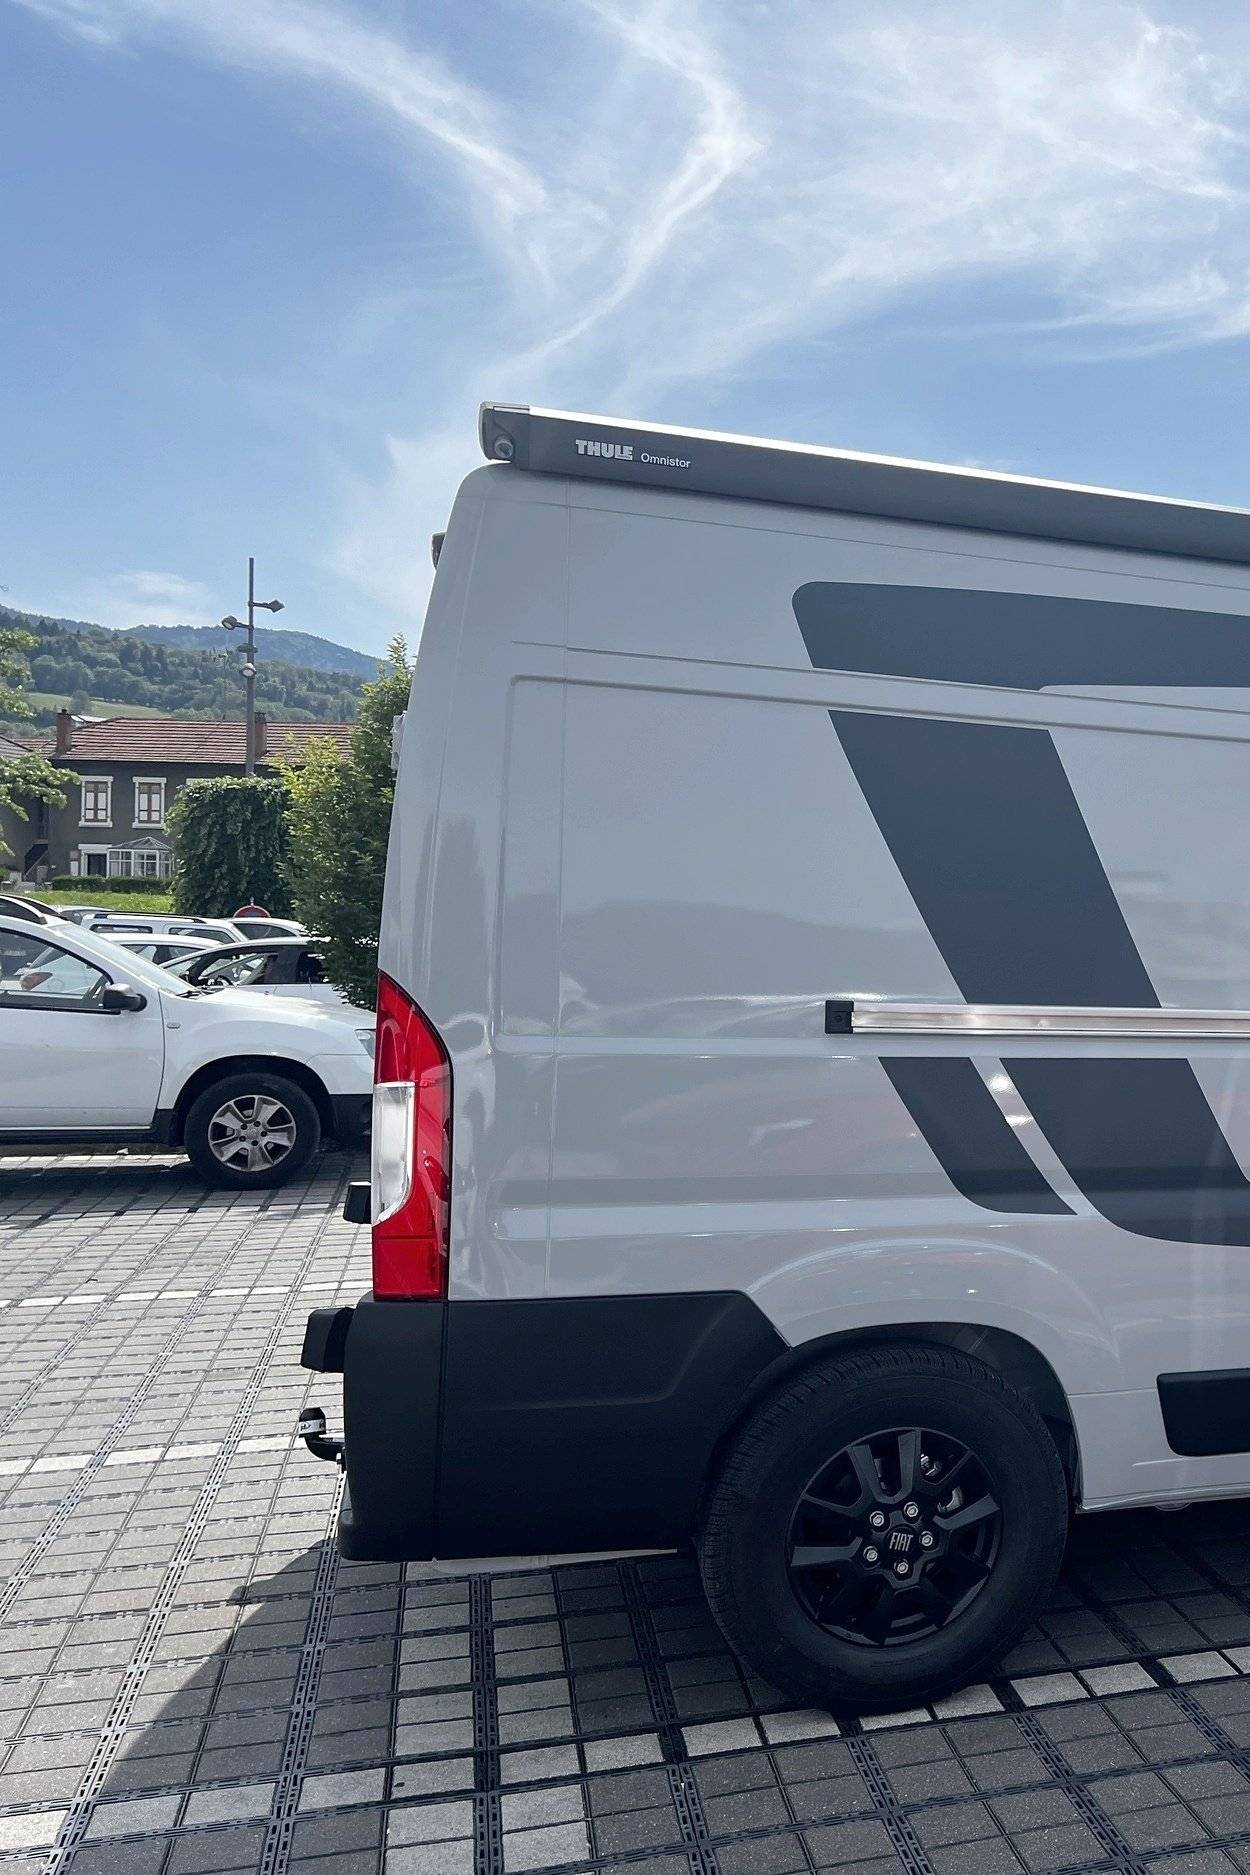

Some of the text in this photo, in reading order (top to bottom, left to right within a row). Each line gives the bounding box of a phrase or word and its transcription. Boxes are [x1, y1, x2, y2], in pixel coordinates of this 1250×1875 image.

[575, 439, 691, 469] THULE Omnistor
[889, 1532, 914, 1552] FIAT
